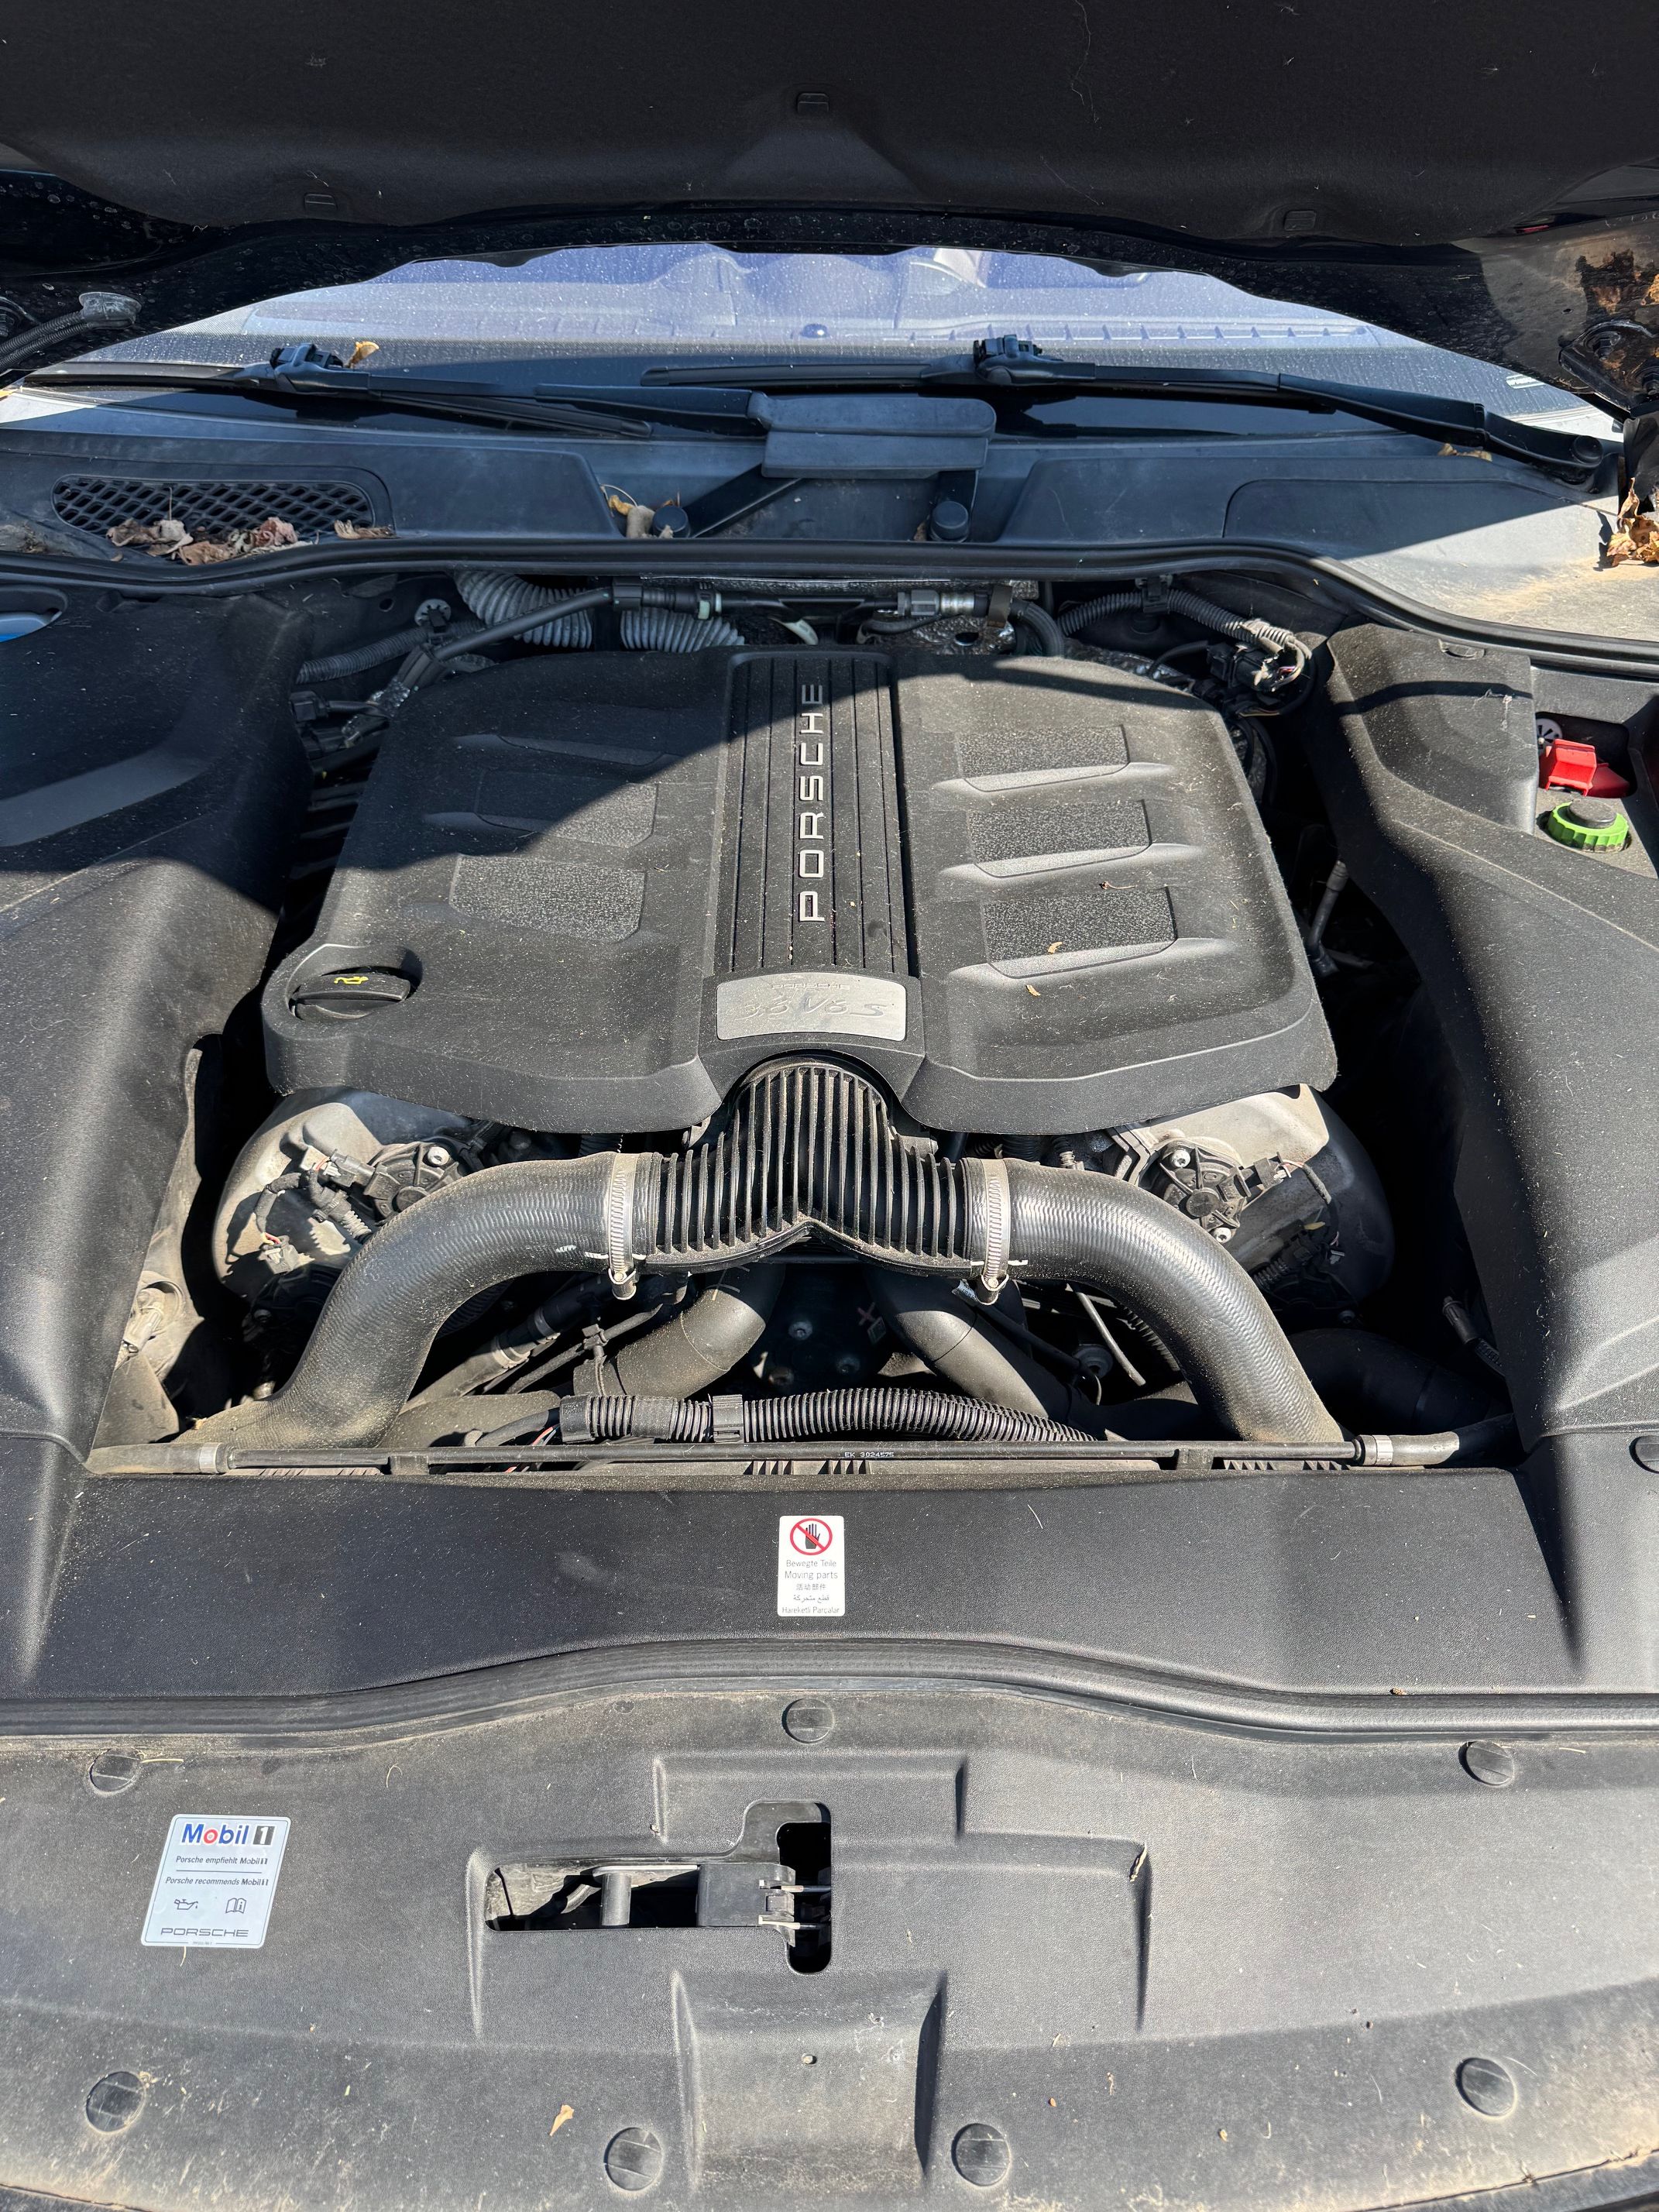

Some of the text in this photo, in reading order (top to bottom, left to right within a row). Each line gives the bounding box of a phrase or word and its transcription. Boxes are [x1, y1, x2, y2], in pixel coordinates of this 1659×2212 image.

[799, 684, 826, 922] PORSCHE
[771, 982, 851, 991] PORSCHE
[804, 997, 850, 1015] V6
[850, 1003, 888, 1018] S
[786, 1559, 837, 1568] Bewegte Teile
[785, 1571, 838, 1581] Moving parts
[812, 1606, 840, 1615] Parçalar
[181, 1823, 250, 1845] Mobil
[175, 1856, 204, 1864] Porsche
[205, 1856, 238, 1866] empfiehlt
[165, 1877, 193, 1885] Porsche
[194, 1877, 240, 1886] recommends
[160, 1928, 249, 1938] PORSCHE
